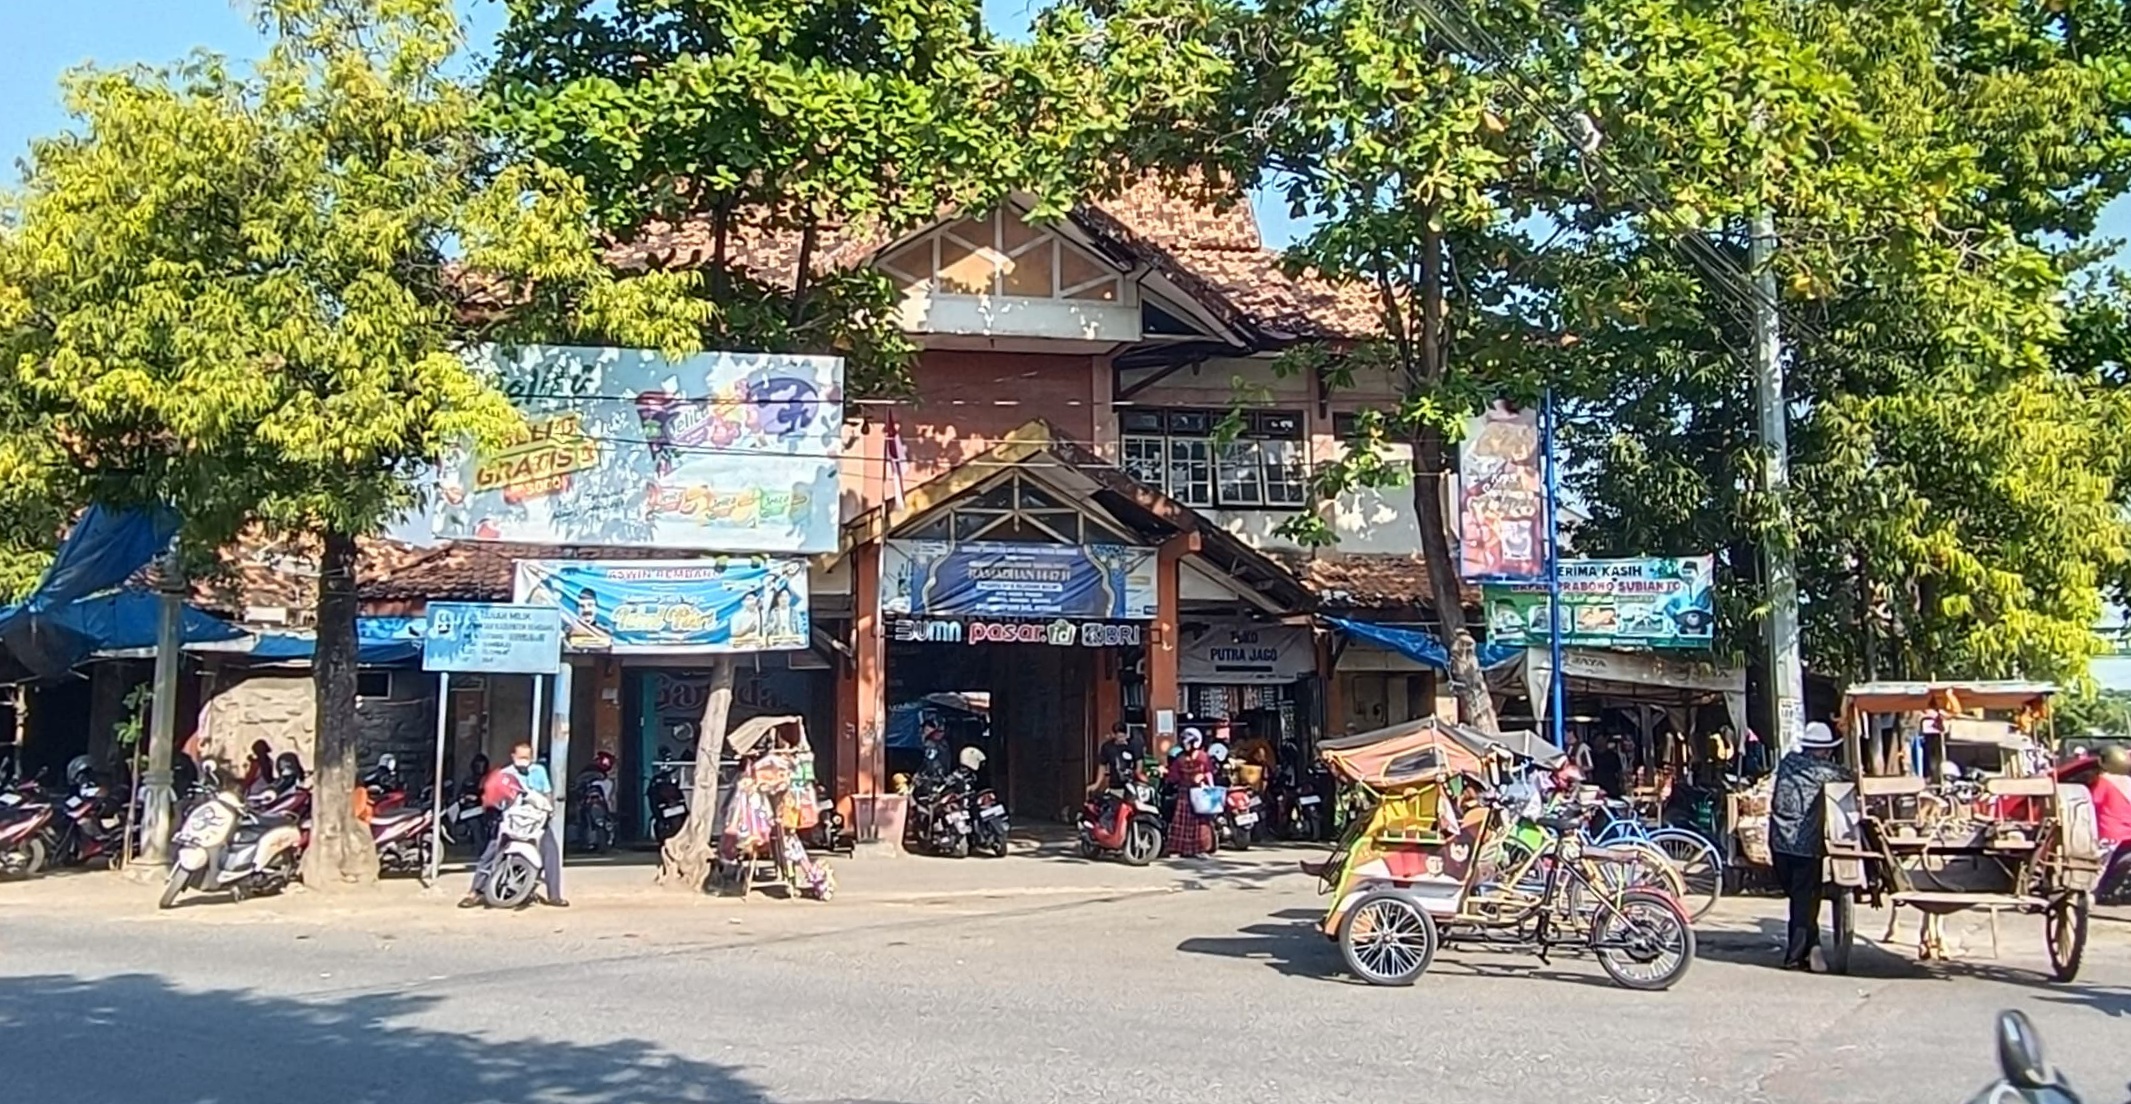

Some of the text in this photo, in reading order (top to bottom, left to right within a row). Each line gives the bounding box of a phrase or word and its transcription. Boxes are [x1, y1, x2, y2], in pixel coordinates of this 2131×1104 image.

[1558, 564, 1642, 577] ERIMA KASIH
[1618, 581, 1681, 593] SUBIANTO
[1210, 648, 1246, 661] PUTRA
